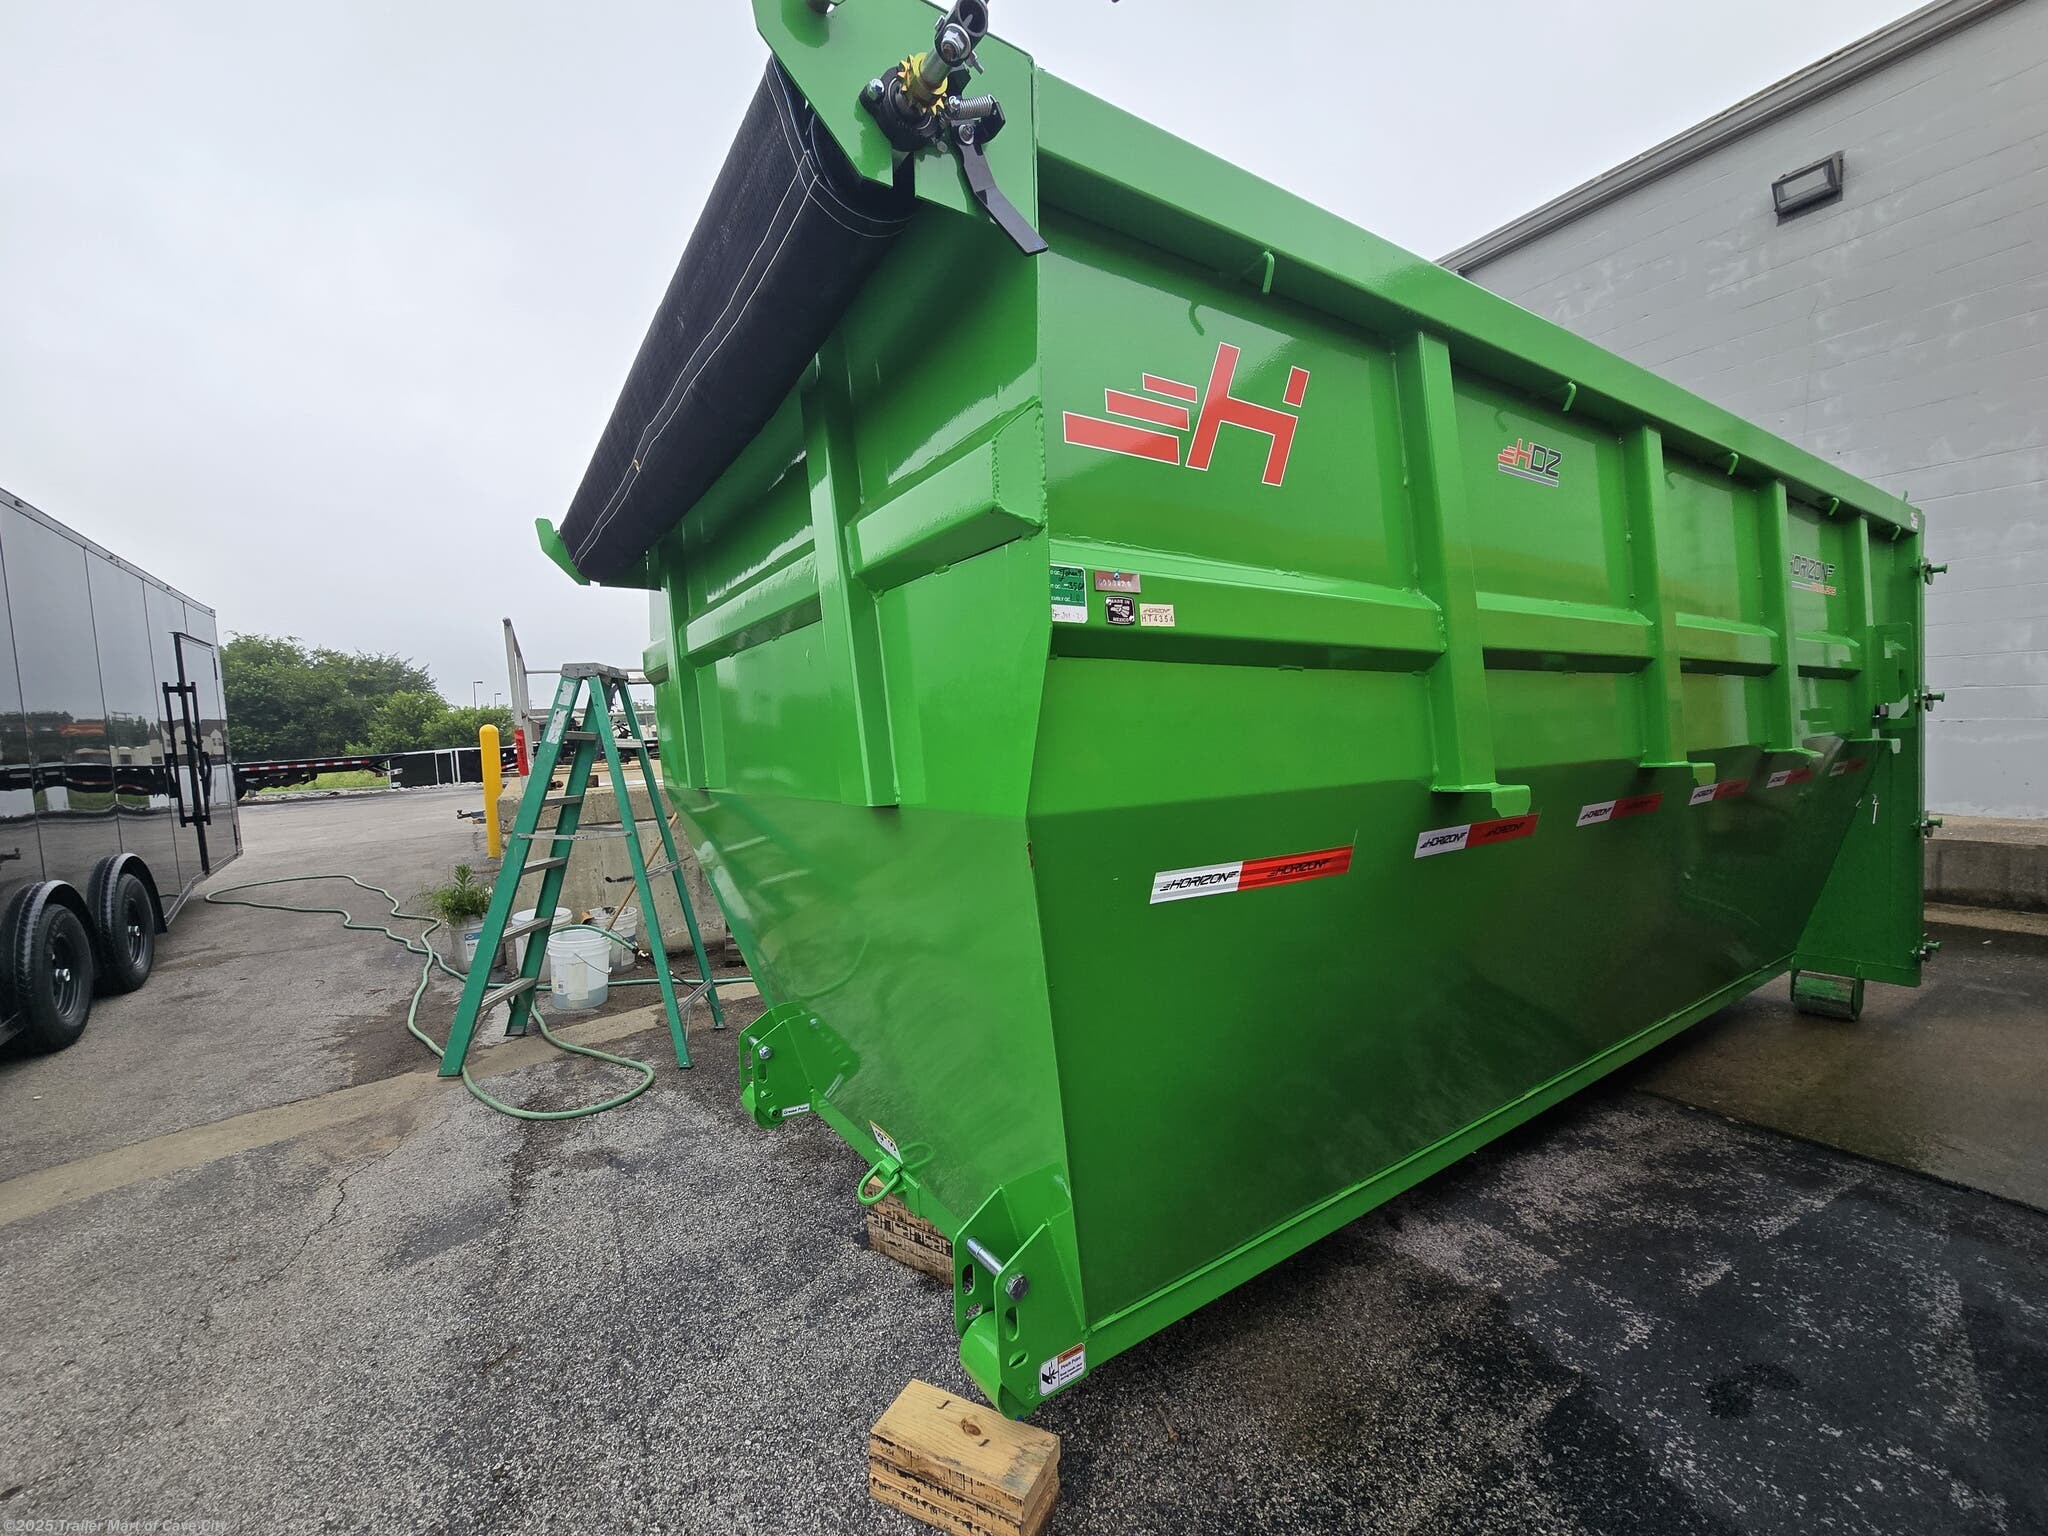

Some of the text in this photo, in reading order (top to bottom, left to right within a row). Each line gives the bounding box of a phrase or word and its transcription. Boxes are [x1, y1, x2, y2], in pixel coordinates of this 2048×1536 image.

[1421, 832, 1467, 848] HORIZON
[1269, 858, 1331, 877] HORIZON
[1162, 871, 1239, 891] HORIZON
